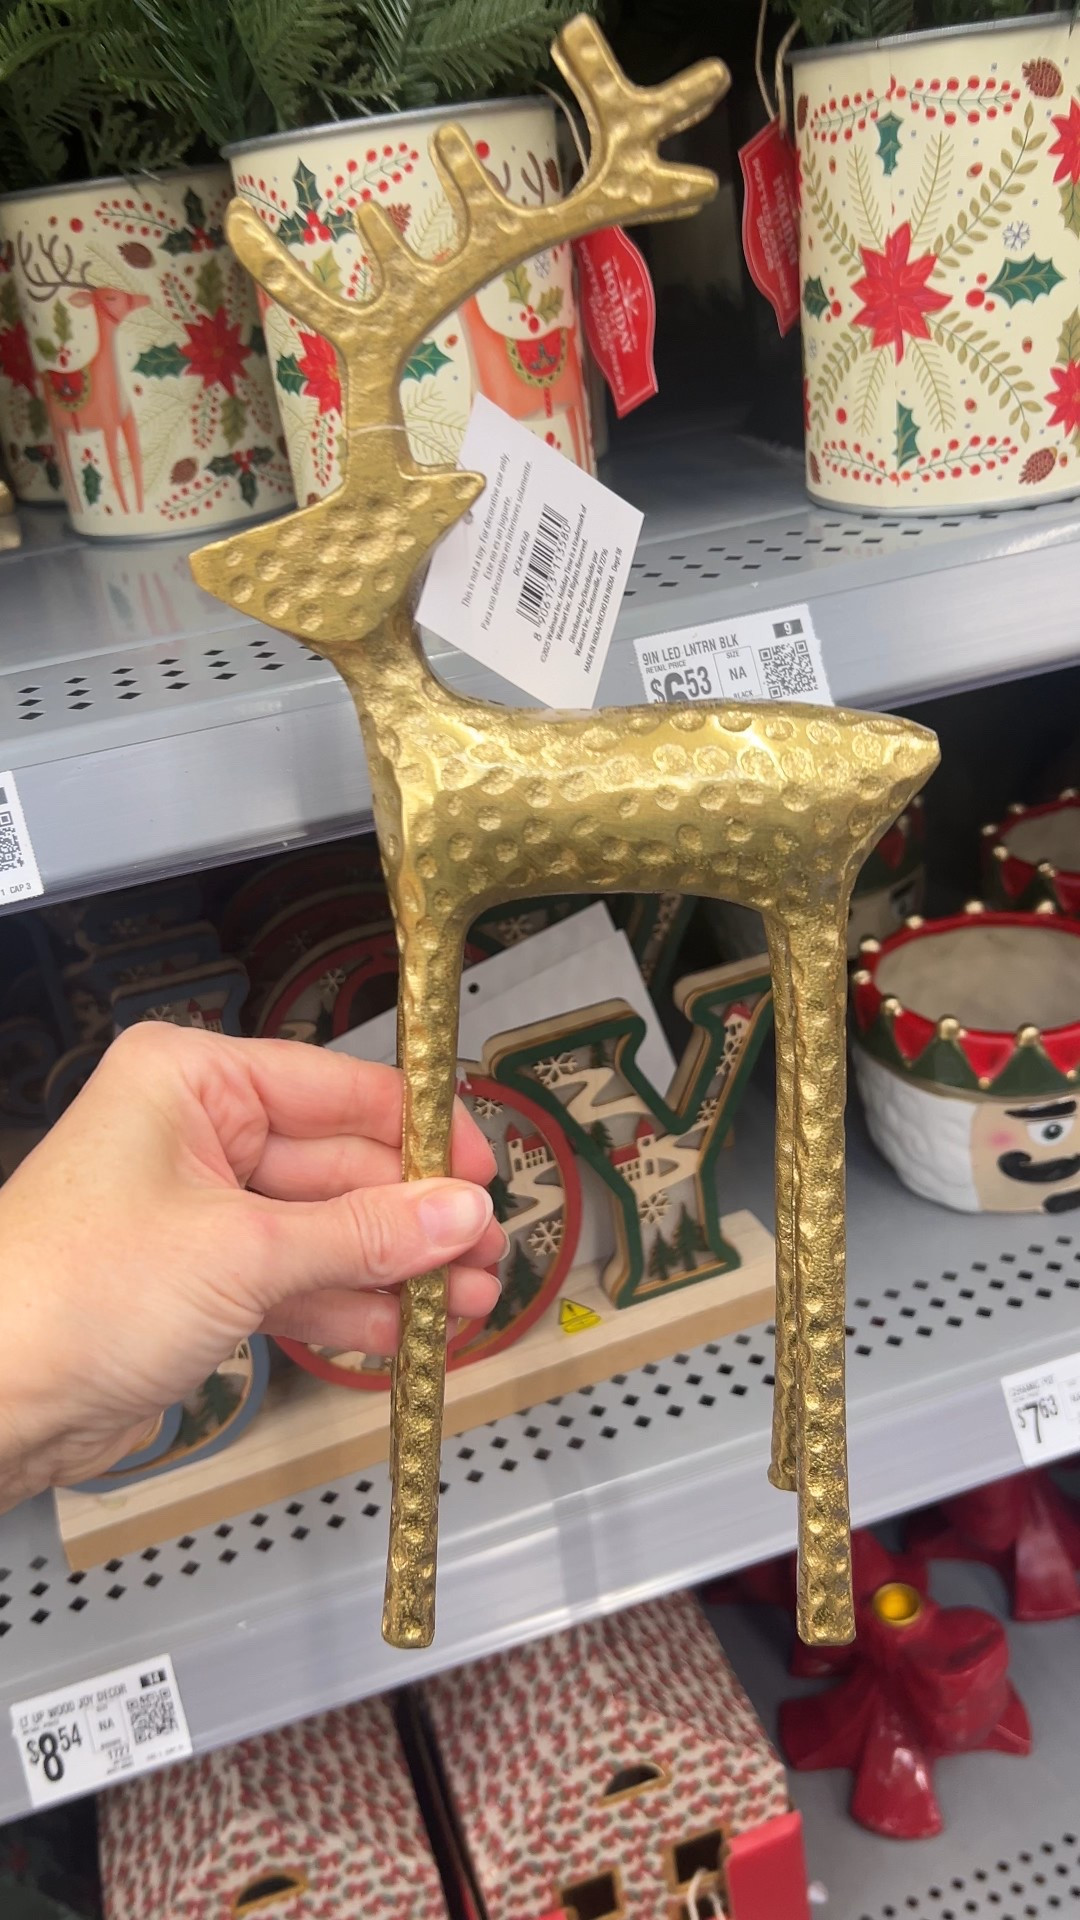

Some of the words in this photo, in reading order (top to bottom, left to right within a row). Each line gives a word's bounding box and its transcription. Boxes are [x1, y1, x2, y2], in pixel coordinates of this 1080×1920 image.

[601, 261, 635, 353] HOLIDAY
[495, 472, 503, 487] use
[516, 461, 531, 503] solamente.
[483, 487, 500, 529] decorative
[505, 503, 521, 542] interiores
[479, 528, 488, 543] For
[495, 528, 503, 540] un
[493, 540, 500, 550] es
[504, 541, 511, 553] en
[513, 531, 530, 576] DC24-66760
[490, 550, 497, 562] no
[470, 566, 479, 582] not
[483, 562, 494, 580] Este
[491, 552, 508, 595] decorativo
[546, 611, 559, 641] Walmart
[557, 574, 570, 600] Holiday
[564, 557, 573, 574] Time
[572, 513, 585, 547] trademark
[580, 504, 587, 514] of
[467, 582, 475, 590] is
[533, 632, 542, 642] 8
[538, 576, 557, 624] 906173
[552, 522, 571, 569] 113580
[461, 590, 472, 608] This
[488, 595, 496, 611] uso
[555, 611, 568, 641] Walmart
[569, 569, 580, 591] Rights
[574, 627, 587, 656] Walmart
[596, 565, 603, 576] AR
[584, 653, 594, 673] MADE
[591, 602, 607, 645] INDIA/HECHO
[605, 575, 615, 595] INDIA
[611, 555, 620, 572] Dept
[481, 611, 492, 631] Para
[569, 606, 583, 644] Distributed
[784, 622, 792, 635] 9
[642, 651, 659, 666] 9IN
[661, 646, 681, 661] LED
[683, 639, 717, 657] LNTRN
[719, 634, 739, 649] BLK
[726, 651, 739, 659] SIZE
[646, 664, 666, 674] RETAIL
[668, 660, 686, 669] PRICE
[729, 666, 747, 680] NA
[10, 884, 24, 894] CAP
[26, 882, 31, 890] 3
[48, 1701, 75, 1718] WOOD
[78, 1694, 93, 1709] JOY
[96, 1684, 127, 1702] DECOR
[98, 1718, 114, 1731] NA
